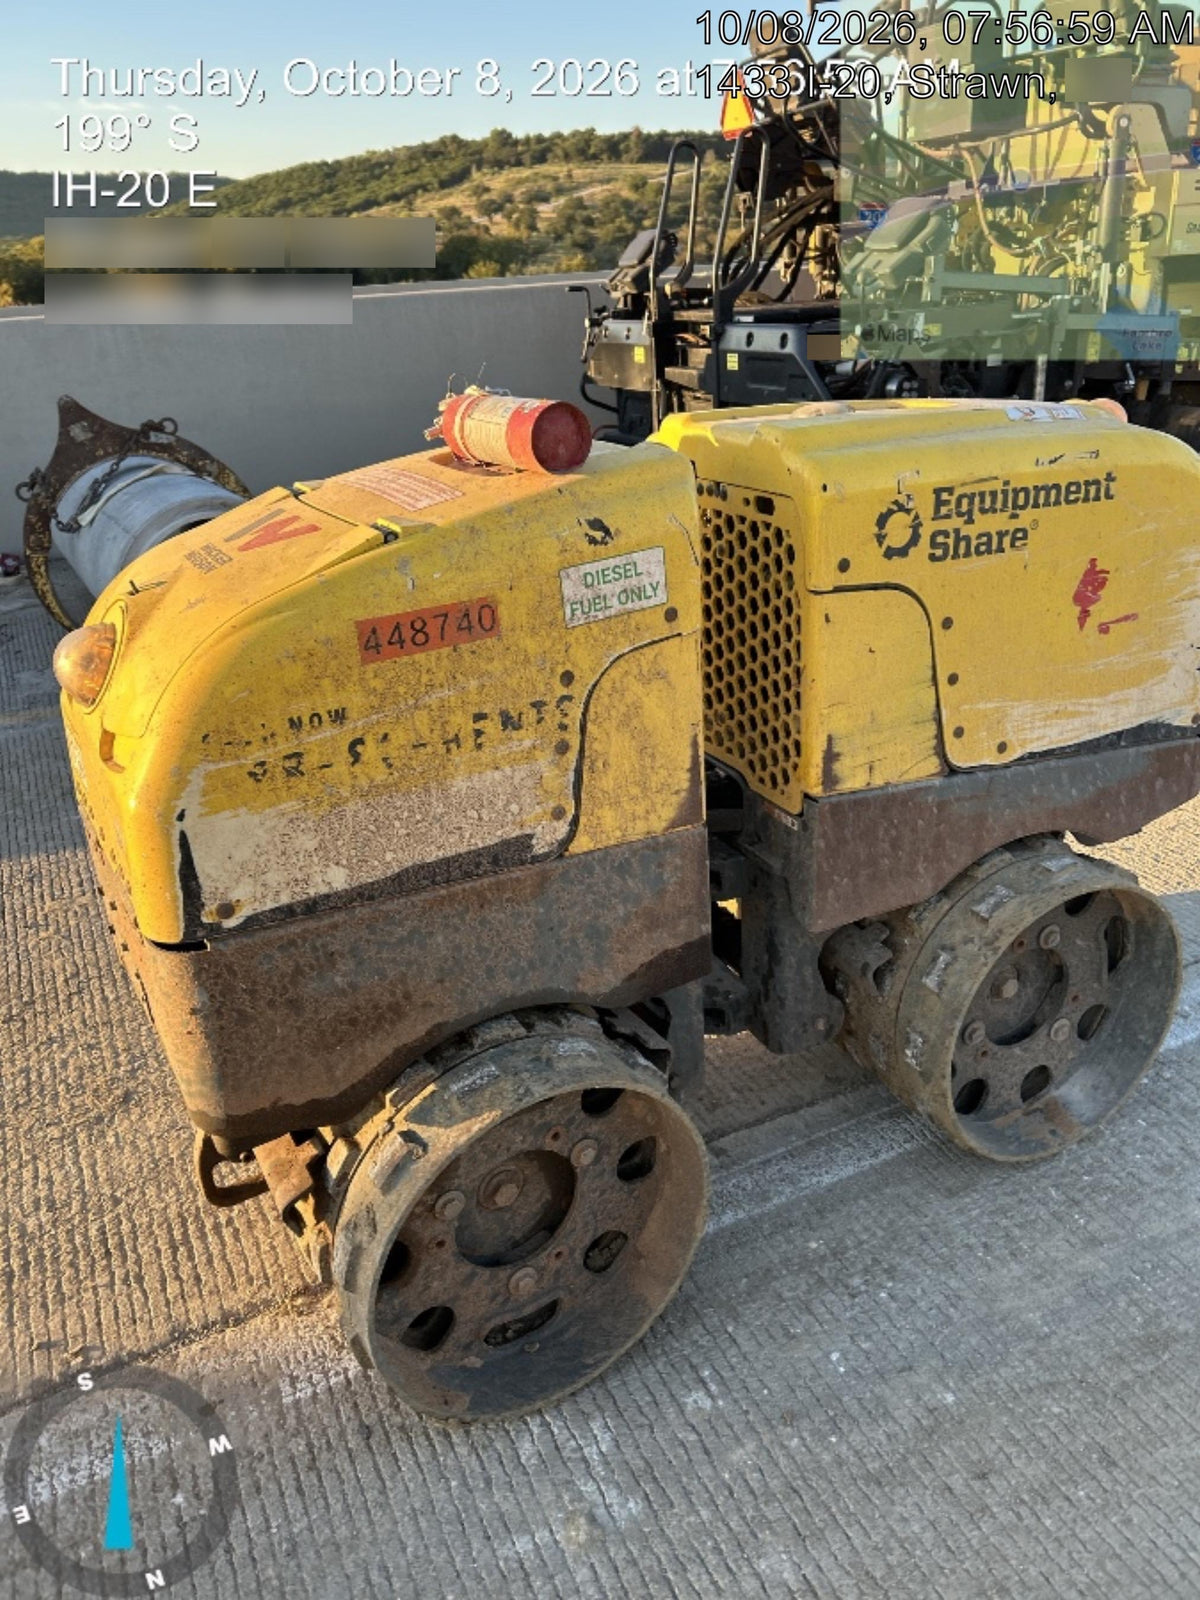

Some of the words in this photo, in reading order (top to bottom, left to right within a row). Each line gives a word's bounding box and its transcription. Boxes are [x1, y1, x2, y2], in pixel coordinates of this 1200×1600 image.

[932, 471, 1117, 525] Equipment
[583, 561, 643, 589] DIESEL
[570, 598, 613, 618] FUEL
[617, 582, 661, 606] ONLY
[363, 604, 497, 655] 448740
